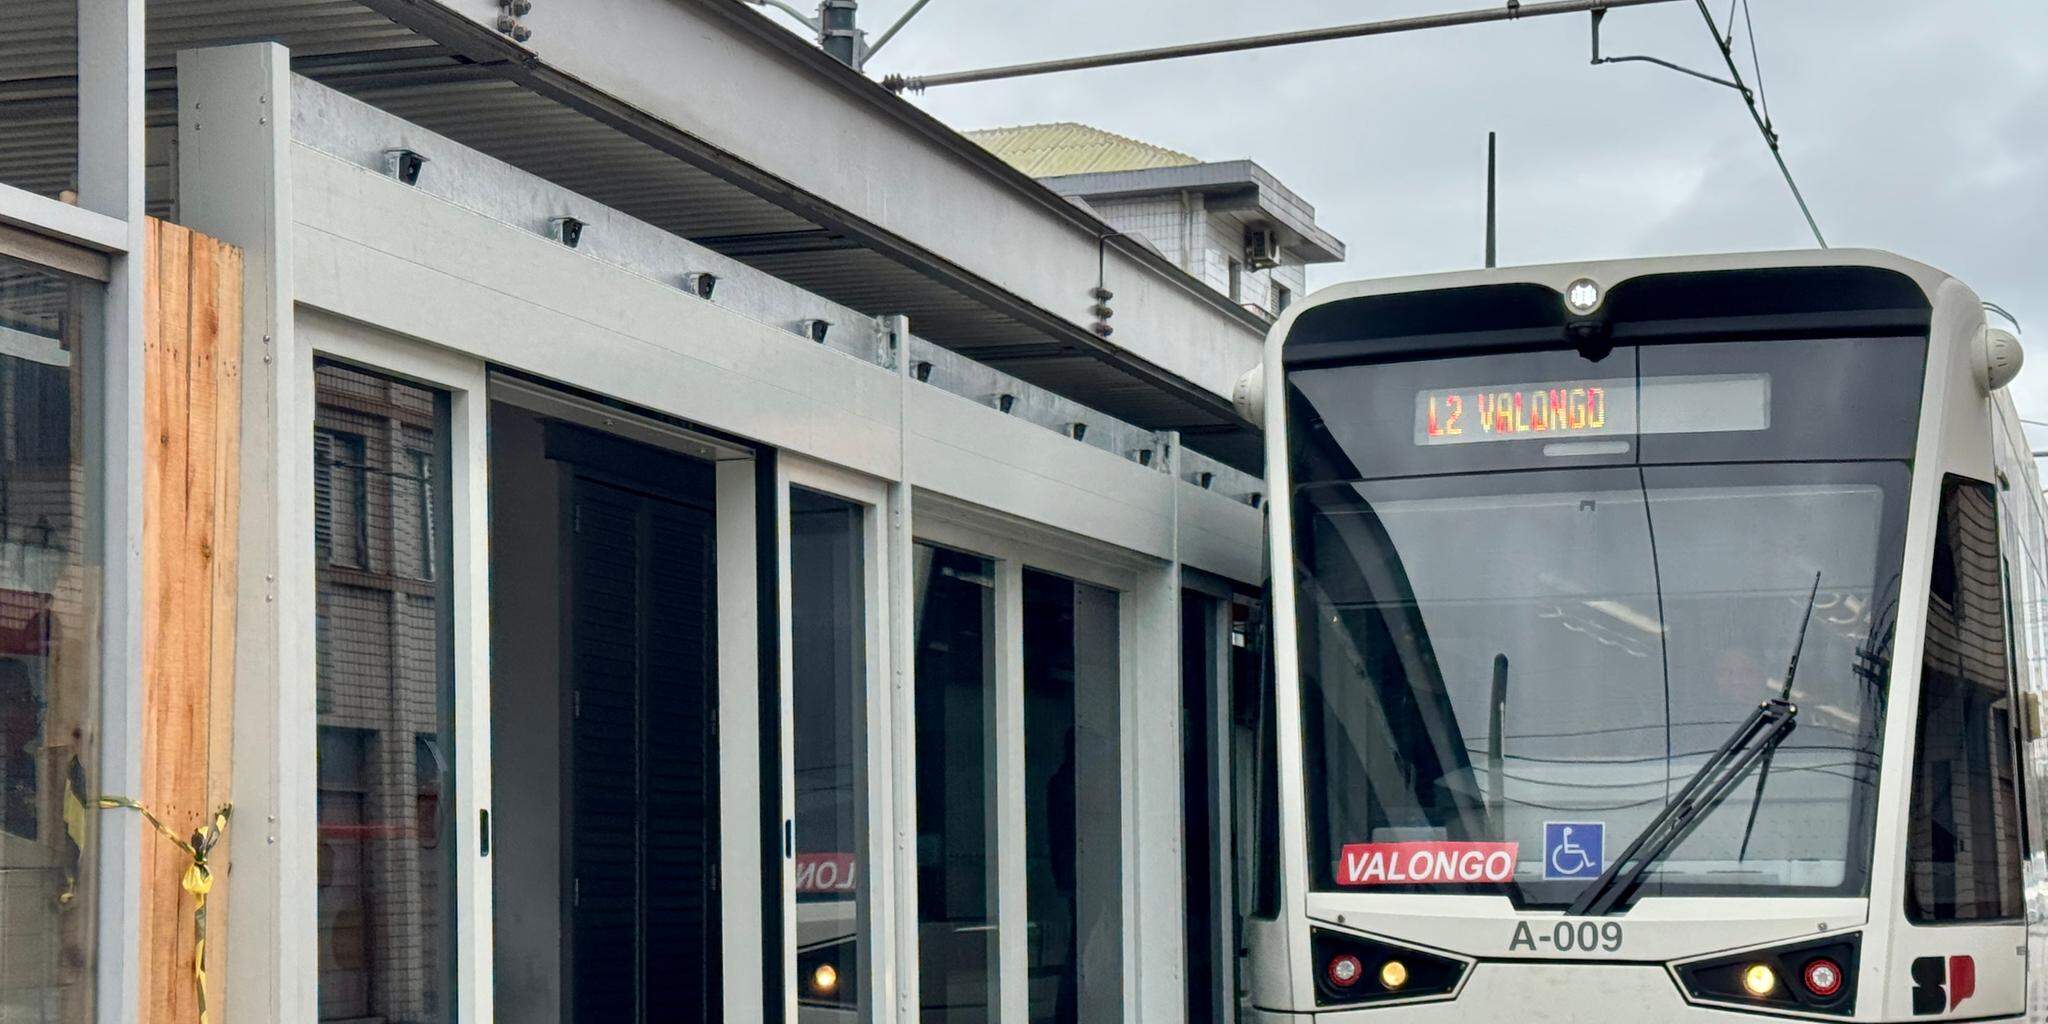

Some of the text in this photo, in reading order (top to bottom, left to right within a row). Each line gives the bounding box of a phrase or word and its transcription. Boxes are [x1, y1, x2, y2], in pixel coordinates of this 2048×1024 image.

[1428, 387, 1605, 436] L2 VALONGO
[1347, 850, 1512, 882] VALONGO
[1508, 920, 1623, 952] A-009
